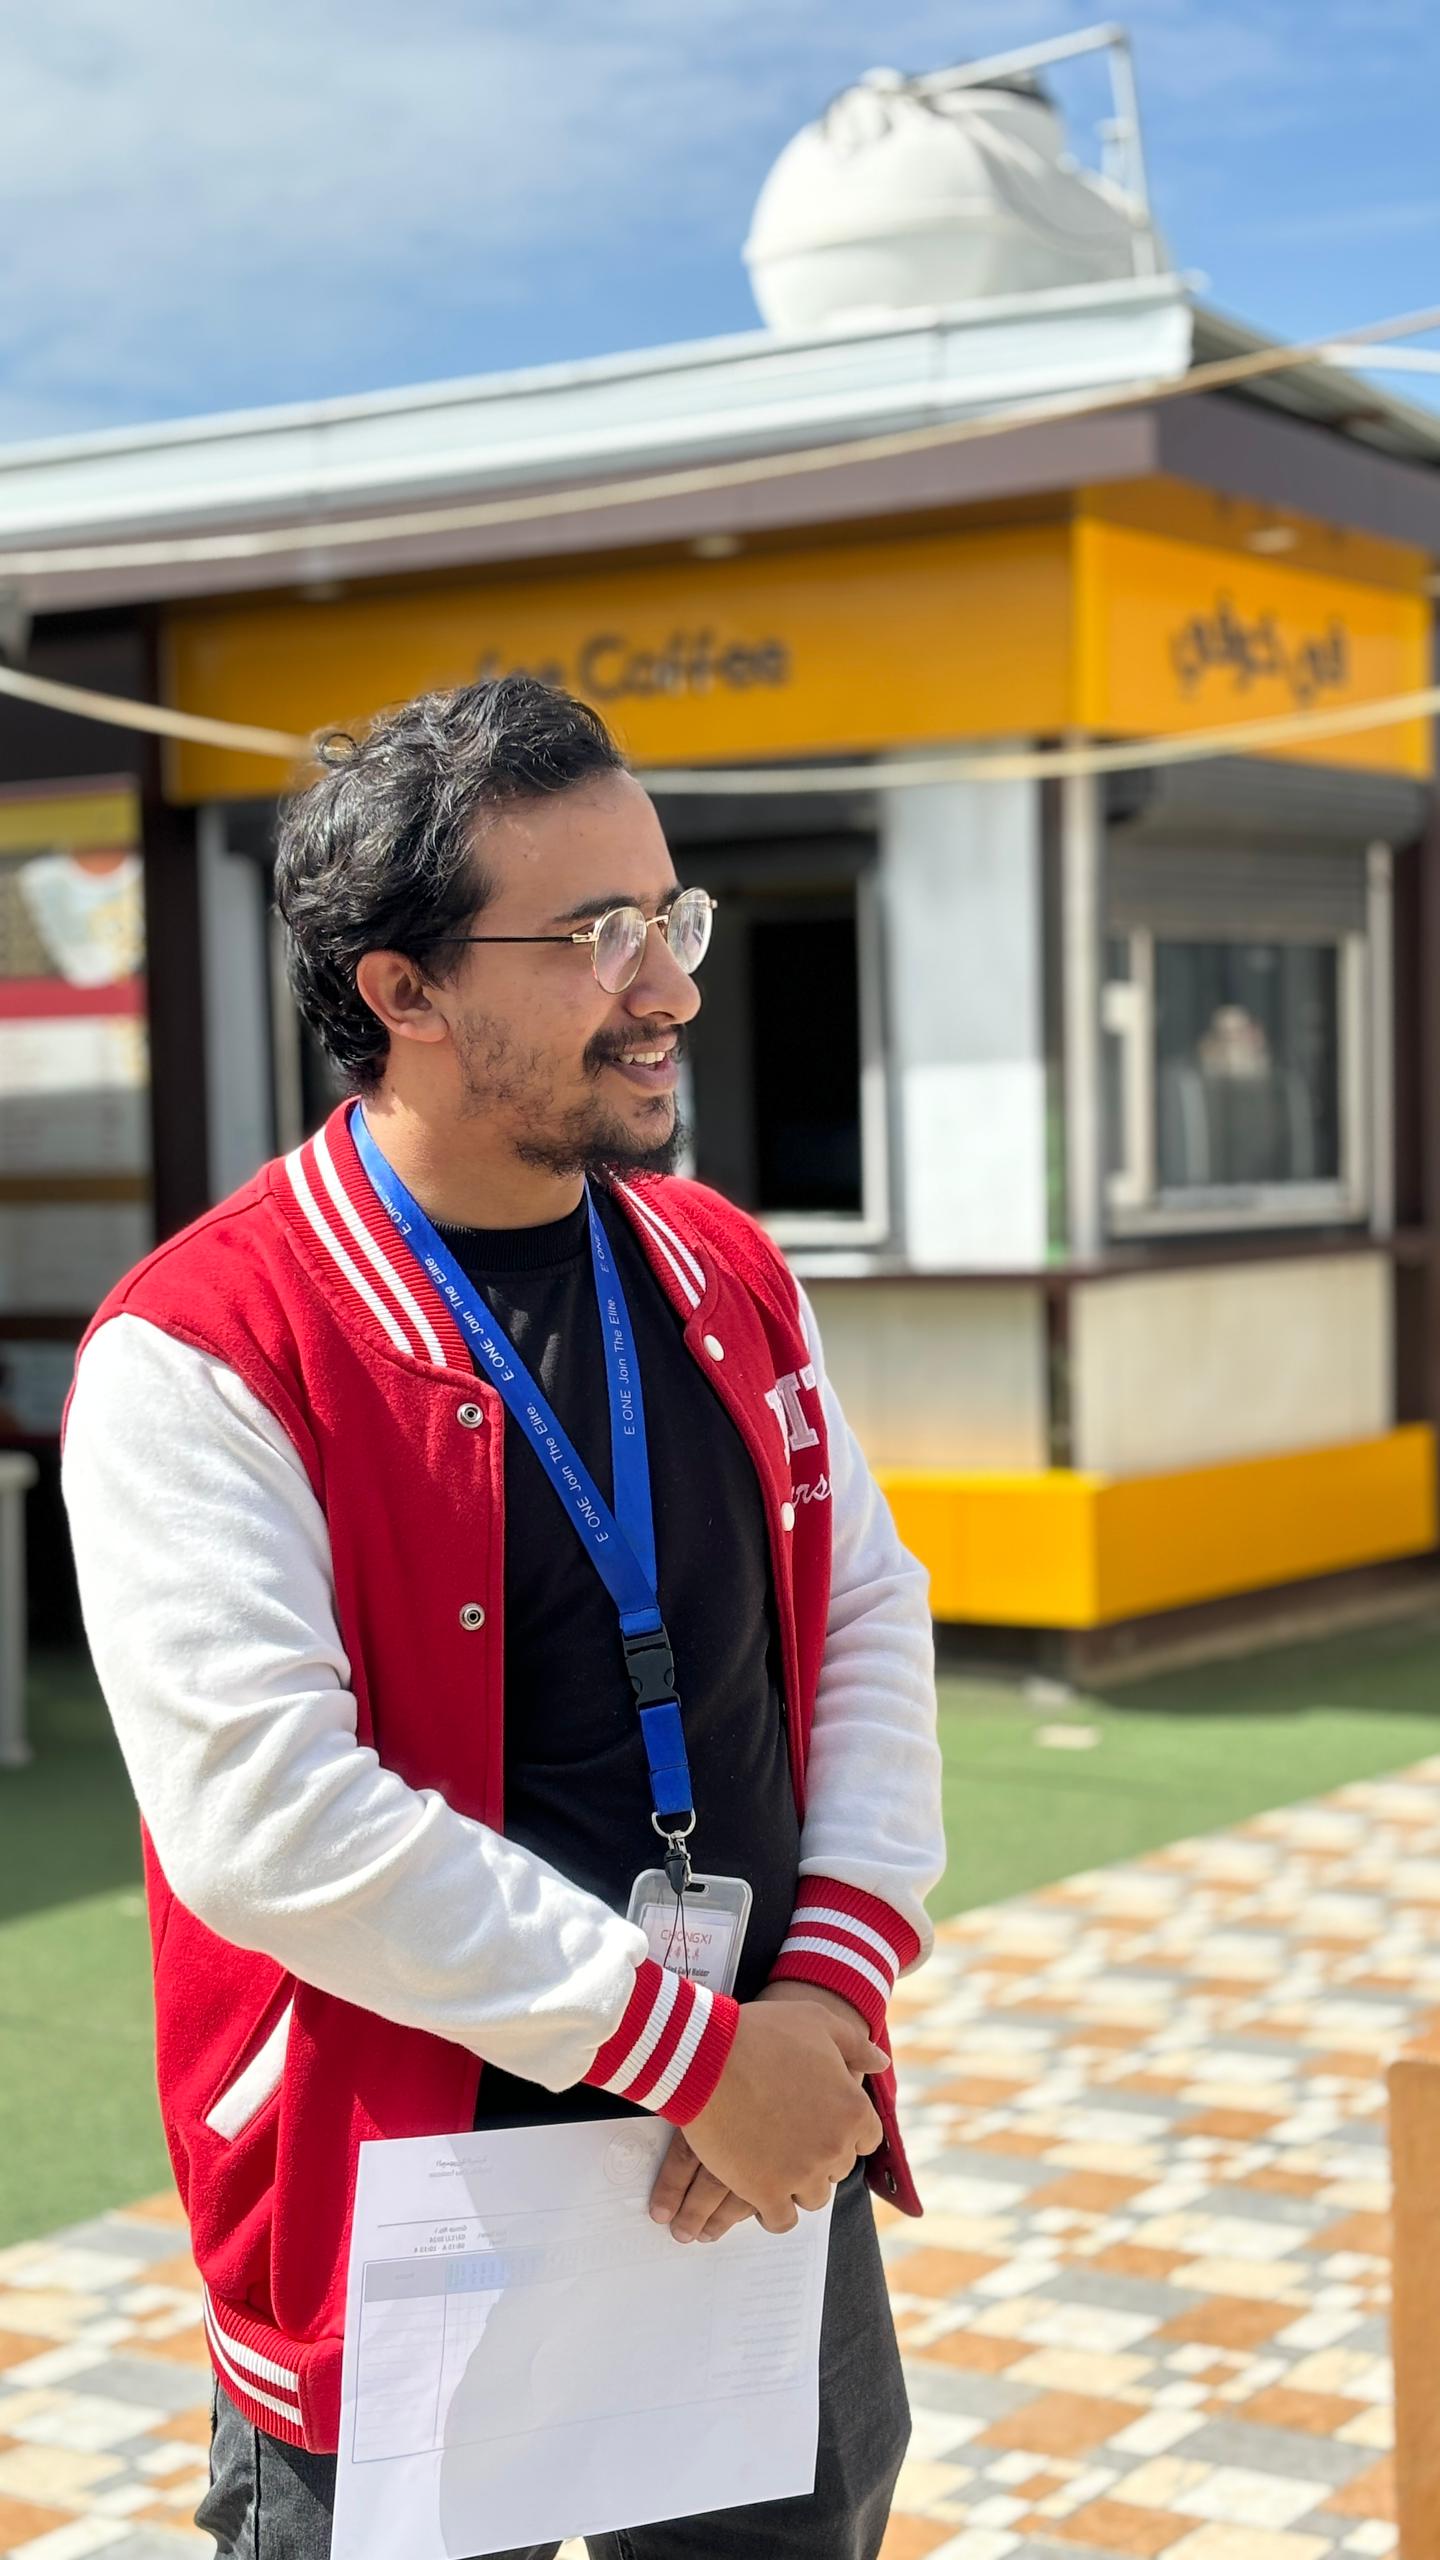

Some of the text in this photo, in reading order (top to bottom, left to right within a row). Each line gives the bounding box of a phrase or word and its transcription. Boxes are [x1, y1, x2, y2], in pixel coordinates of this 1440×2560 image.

[578, 627, 789, 702] Coffee
[424, 1253, 448, 1284] Elite.
[444, 1285, 464, 1310] The
[462, 1310, 484, 1335] Join
[613, 1329, 625, 1353] The
[618, 1358, 630, 1384] Join
[545, 1437, 563, 1464] The
[561, 1465, 582, 1491] Join
[660, 1929, 712, 1945] CHONGXI
